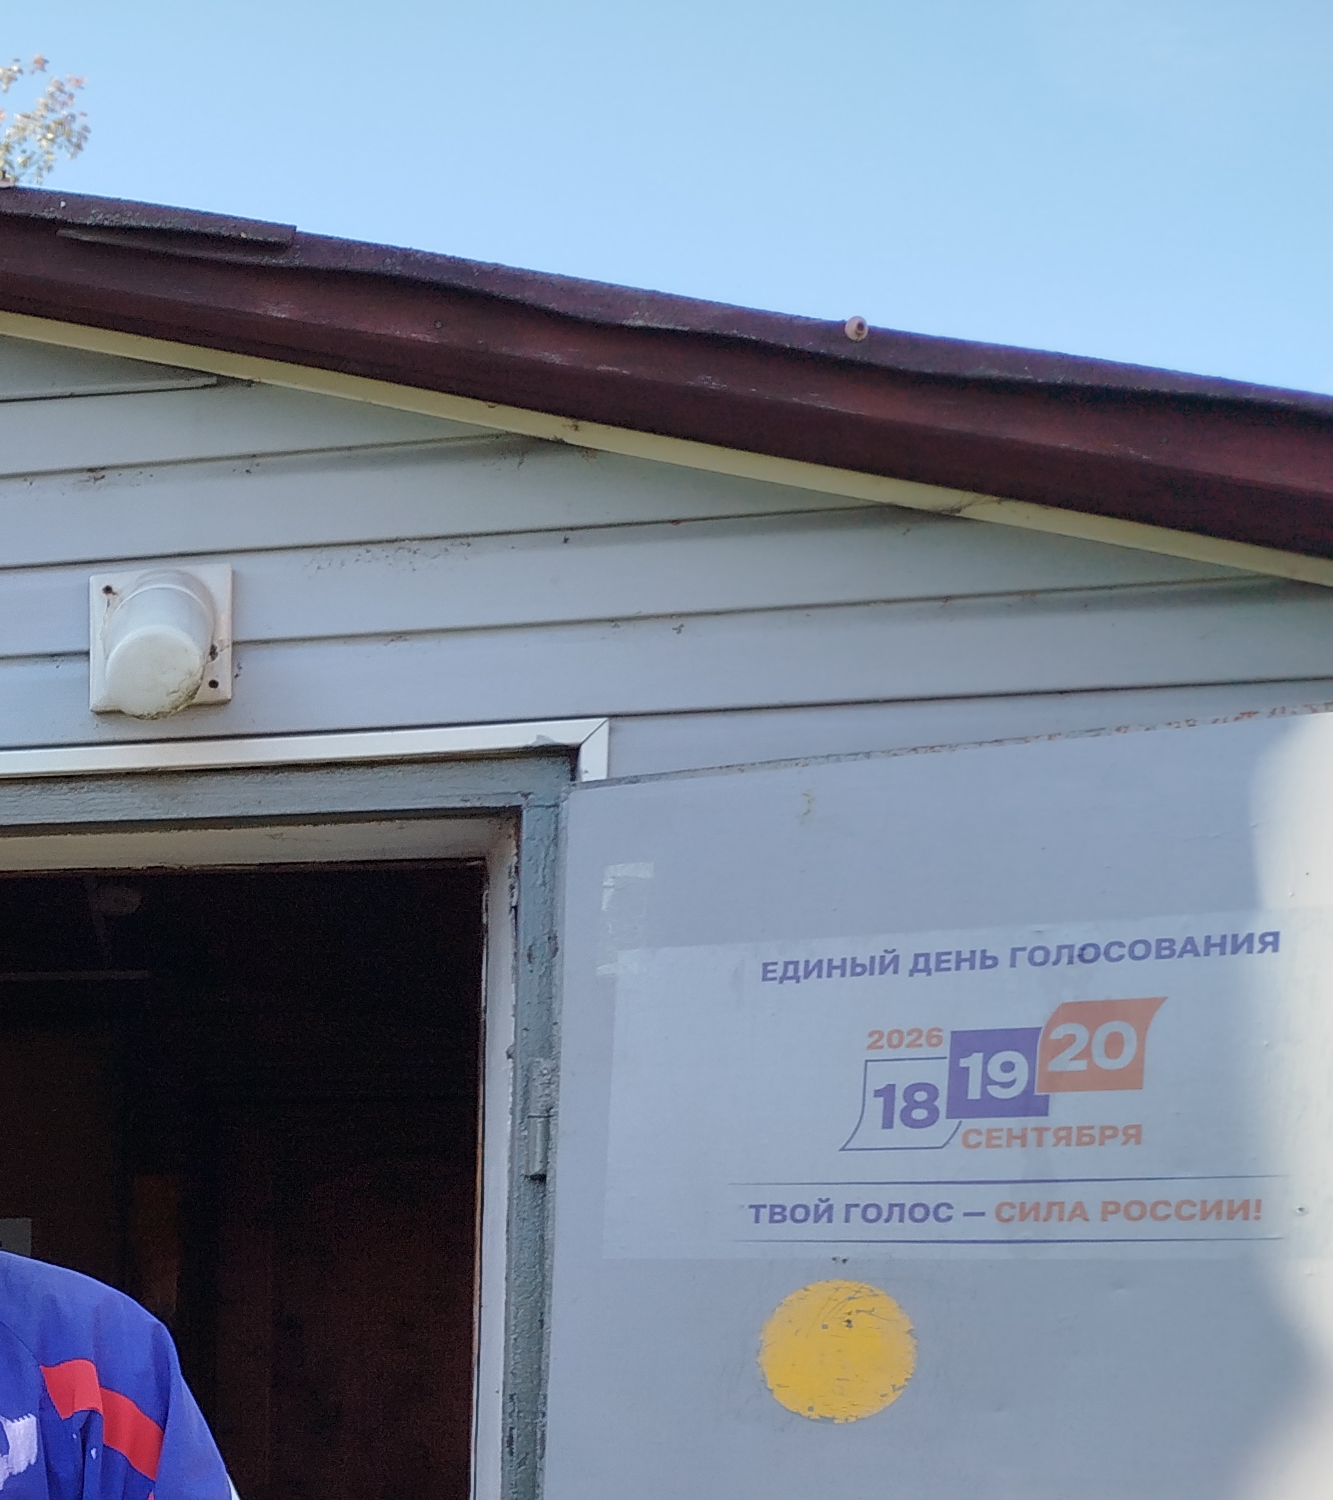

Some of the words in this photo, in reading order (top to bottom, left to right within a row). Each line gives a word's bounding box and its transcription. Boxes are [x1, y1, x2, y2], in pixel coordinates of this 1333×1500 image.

[761, 949, 900, 984] ЕДИНЫЙ
[909, 951, 999, 978] ДЕНЬ
[1009, 931, 1280, 970] ГОЛОСОВАНИЯ
[866, 1027, 944, 1050] 2026
[872, 1082, 940, 1130] 18
[959, 1050, 1029, 1100] 19
[1047, 1021, 1138, 1072] 20
[961, 1124, 1143, 1150] СЕНТЯБРЯ
[749, 1197, 833, 1225] ТВОЙ
[844, 1201, 954, 1224] ГОЛОС
[995, 1200, 1089, 1223] СИЛА
[1100, 1198, 1262, 1222] РОССИИ!
